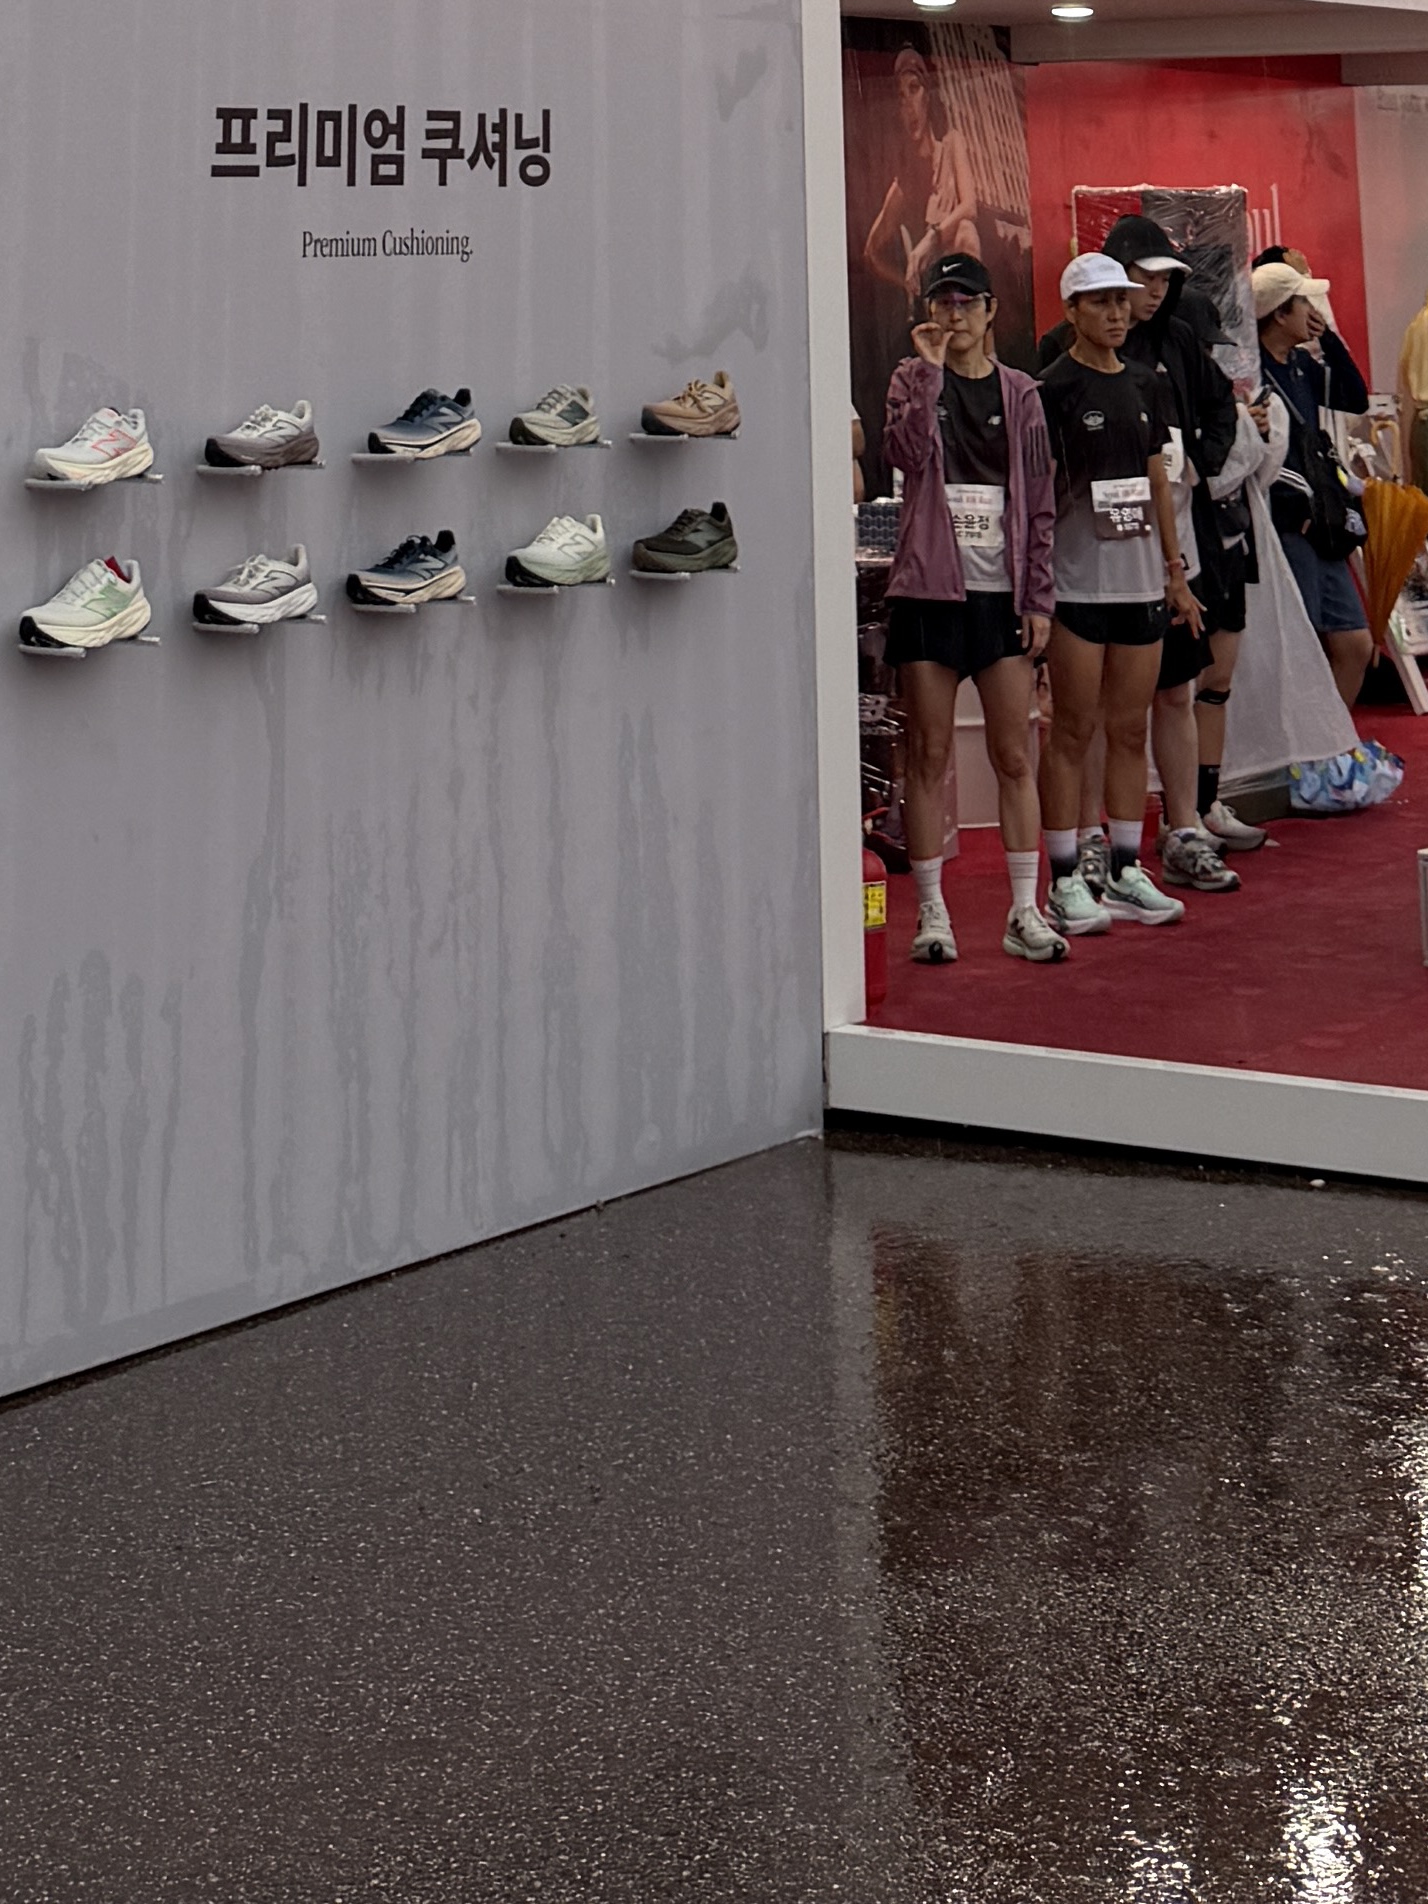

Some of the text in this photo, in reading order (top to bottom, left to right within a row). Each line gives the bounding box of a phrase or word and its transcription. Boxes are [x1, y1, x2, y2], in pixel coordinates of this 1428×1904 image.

[211, 102, 553, 188] 프리미엄 쿠셔닝
[301, 228, 474, 263] Premium Cushioning.
